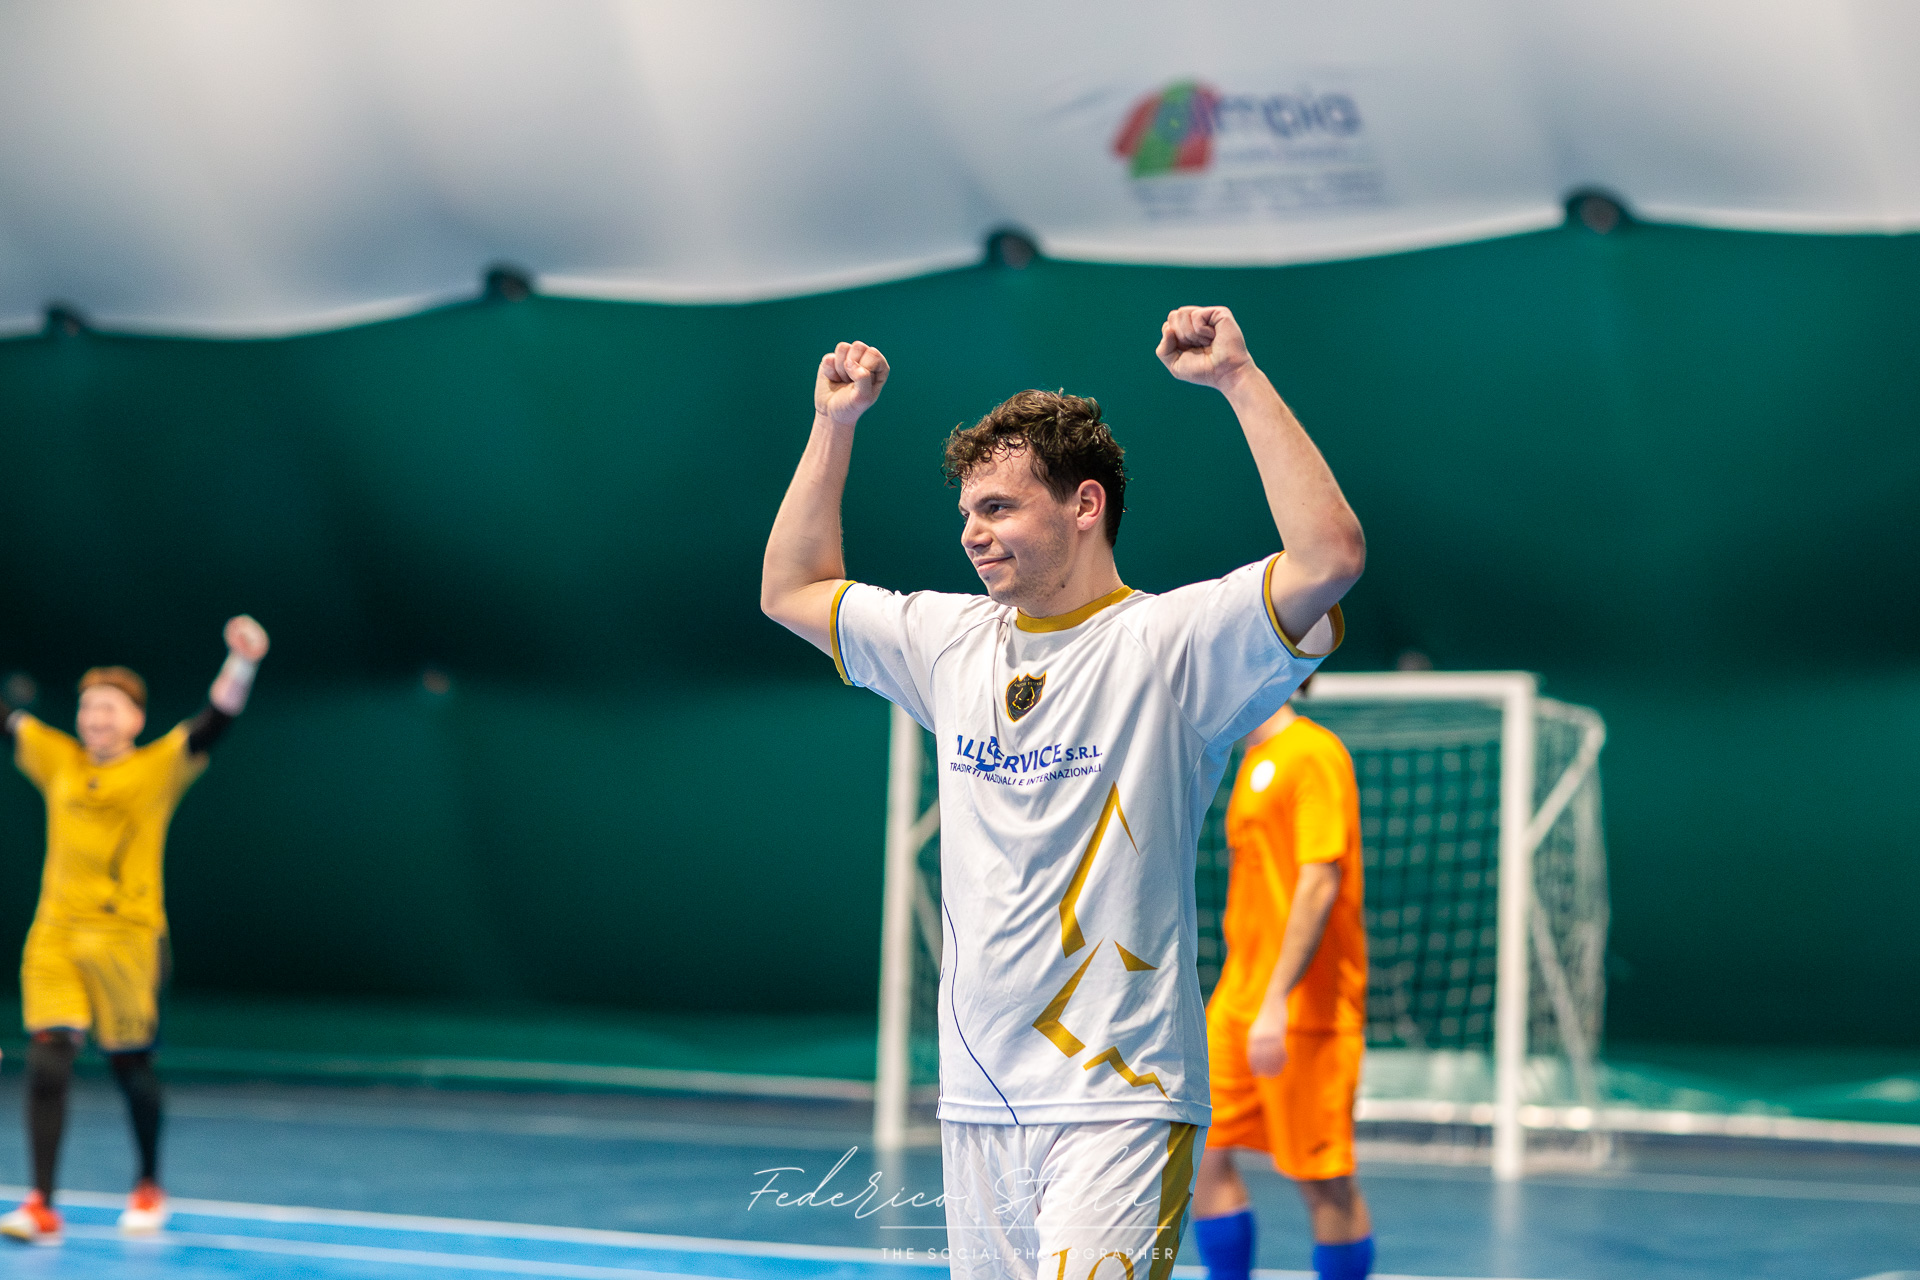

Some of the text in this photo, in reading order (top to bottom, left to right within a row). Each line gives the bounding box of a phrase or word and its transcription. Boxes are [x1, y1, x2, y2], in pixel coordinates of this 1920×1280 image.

[1065, 745, 1103, 761] S.R.L.
[950, 762, 981, 777] TRASRTI
[983, 772, 1016, 786] NAZNALI
[1026, 763, 1102, 786] INTERNAZIONALI
